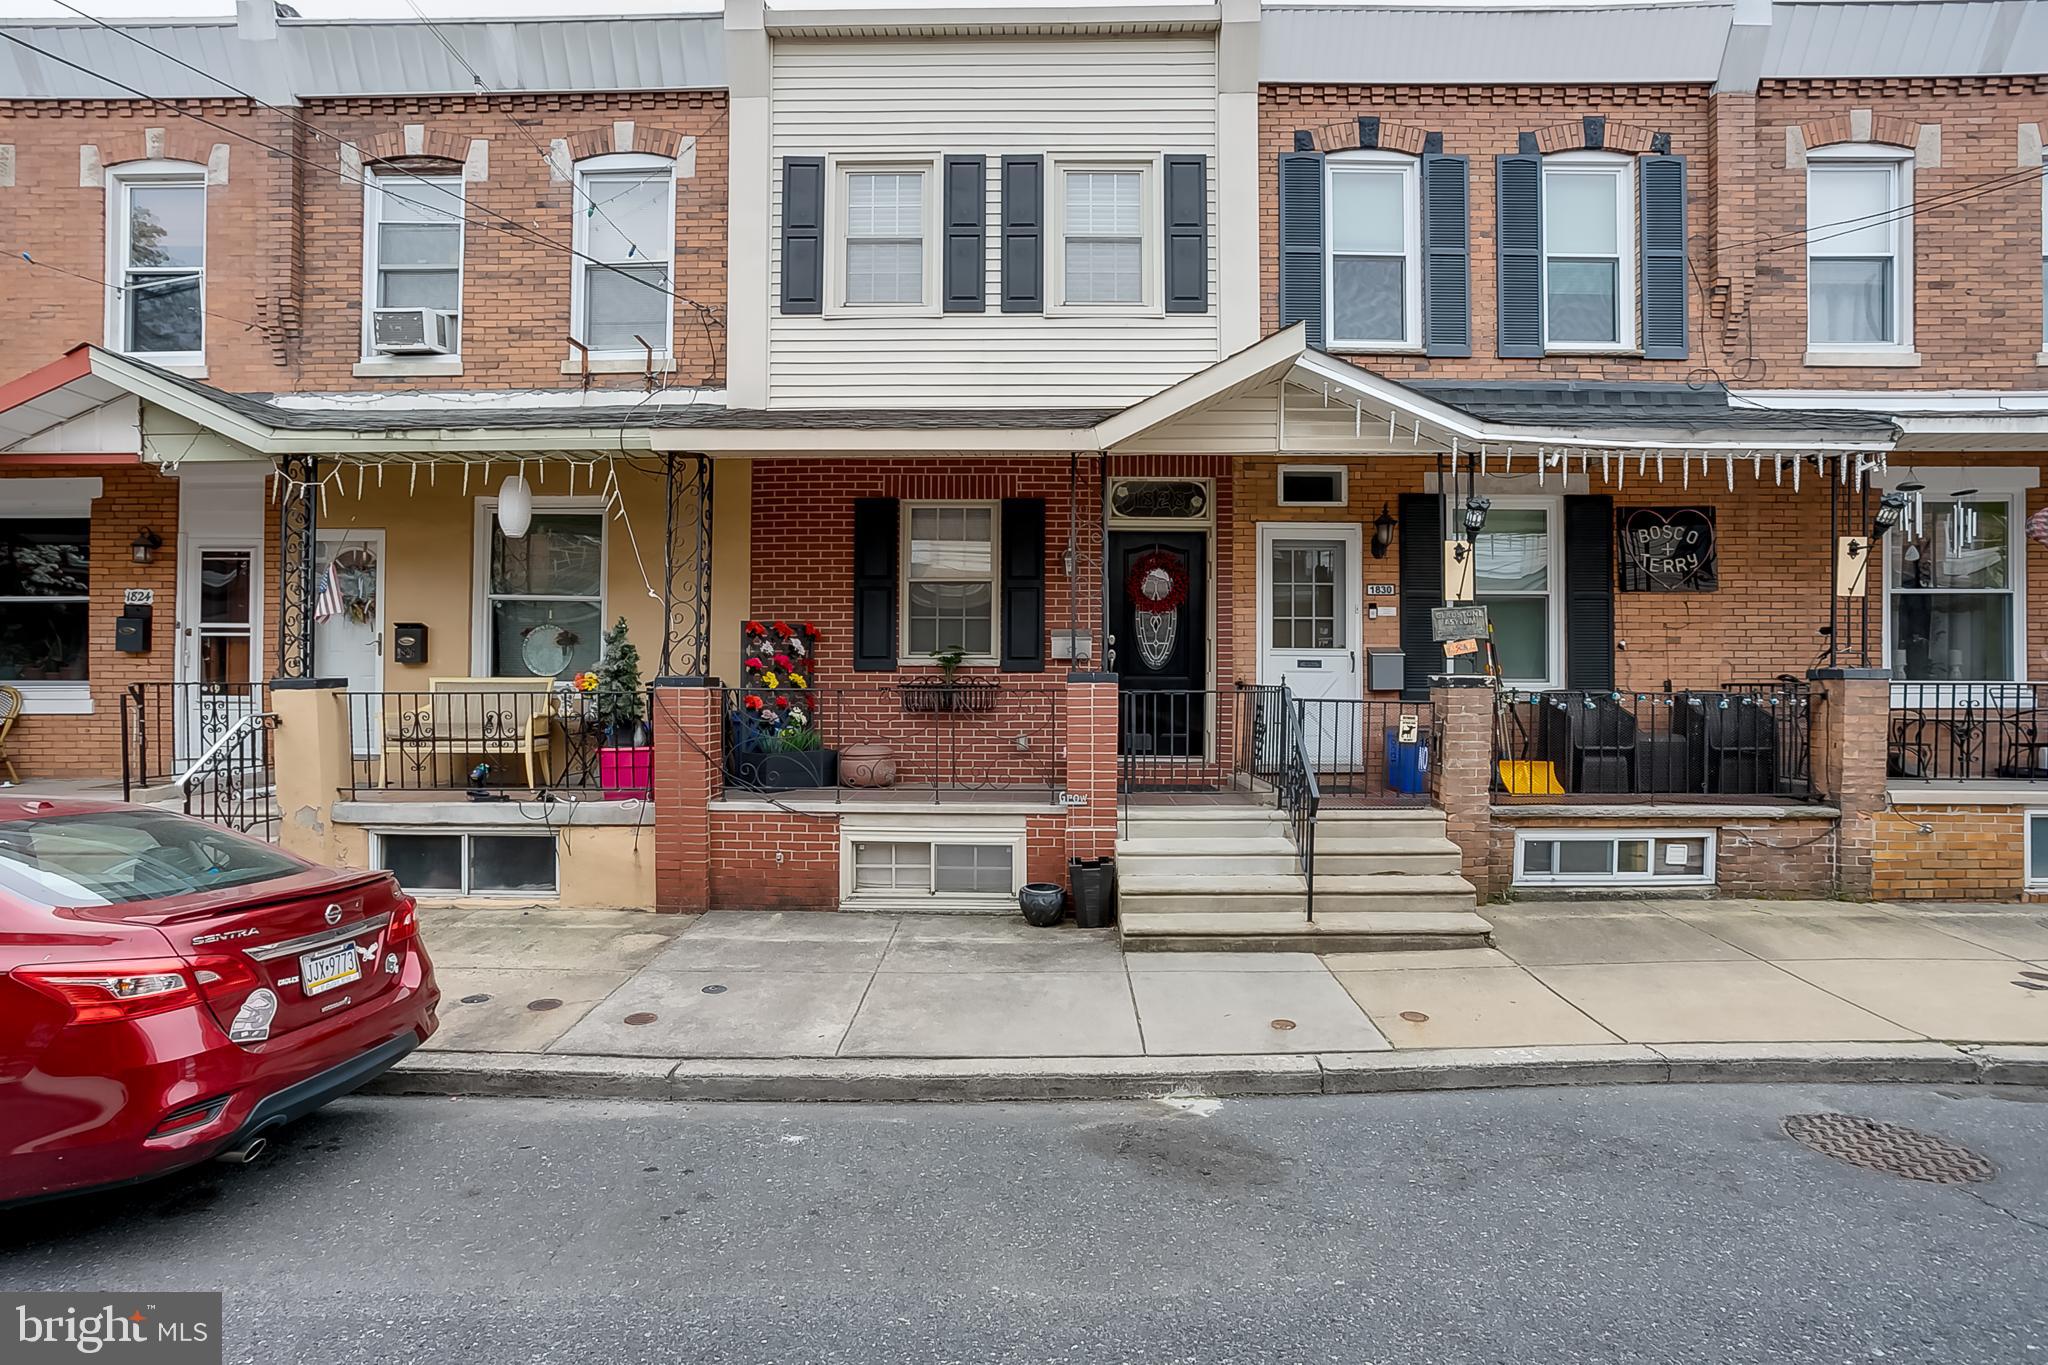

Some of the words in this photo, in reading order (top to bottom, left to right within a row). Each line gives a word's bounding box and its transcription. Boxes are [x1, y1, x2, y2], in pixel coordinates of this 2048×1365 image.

[1638, 525, 1699, 544] BOSCO
[1640, 553, 1699, 573] TERRY
[127, 591, 151, 602] 1824
[1369, 586, 1392, 594] 1830
[1444, 617, 1477, 625] ASYLUM
[1059, 791, 1088, 804] Grow
[192, 928, 260, 946] SENTRA
